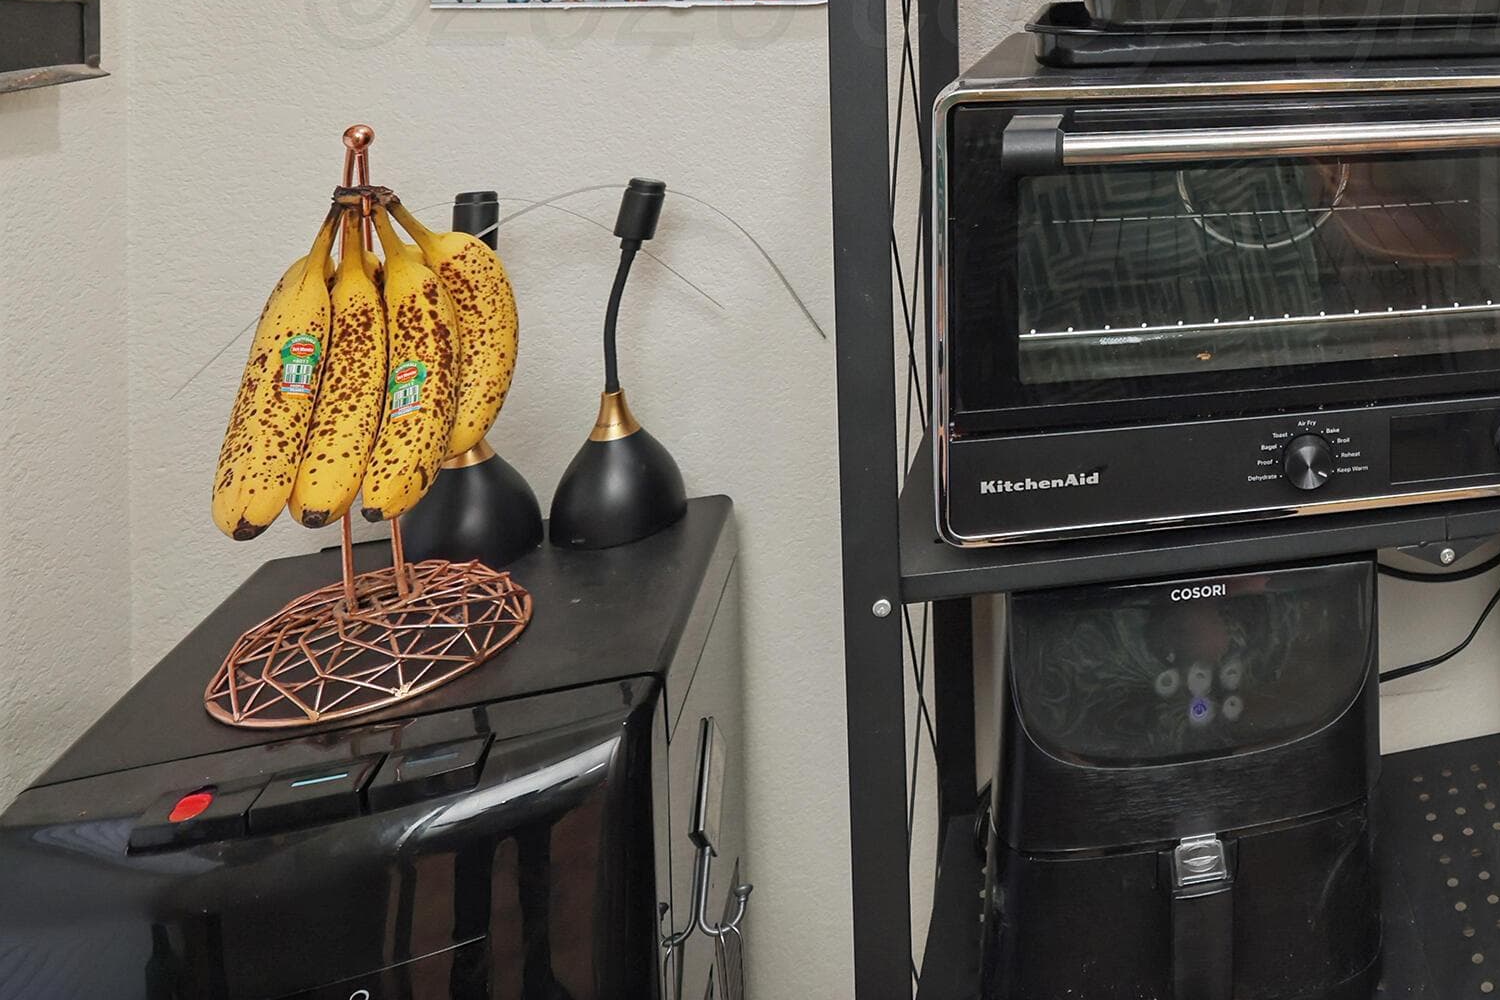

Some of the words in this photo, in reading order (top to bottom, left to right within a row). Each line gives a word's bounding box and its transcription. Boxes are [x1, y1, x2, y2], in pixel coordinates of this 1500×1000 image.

[980, 472, 1100, 494] KitchenAid
[1247, 473, 1277, 482] Dehydrate
[1171, 584, 1226, 601] COSORI
